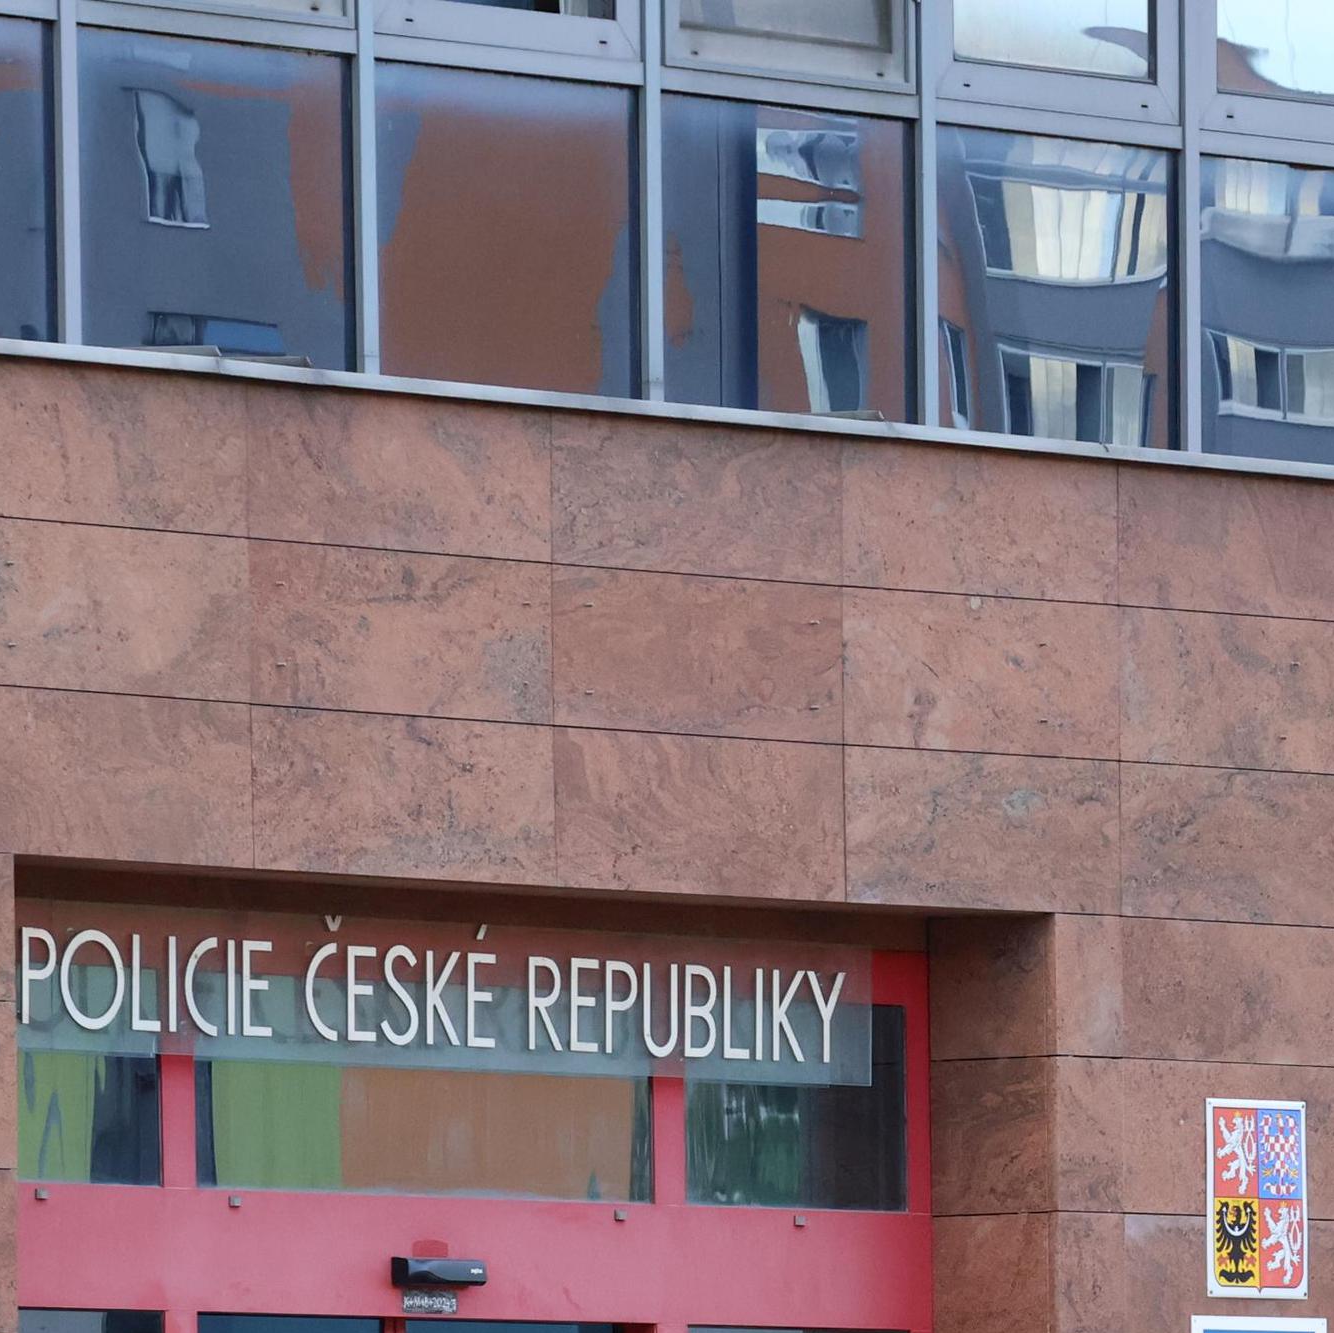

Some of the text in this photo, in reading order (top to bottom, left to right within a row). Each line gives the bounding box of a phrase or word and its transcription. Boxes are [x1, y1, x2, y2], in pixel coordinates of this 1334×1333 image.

[21, 914, 847, 1064] POLICIE ČESKÉ REPUBLIKY
